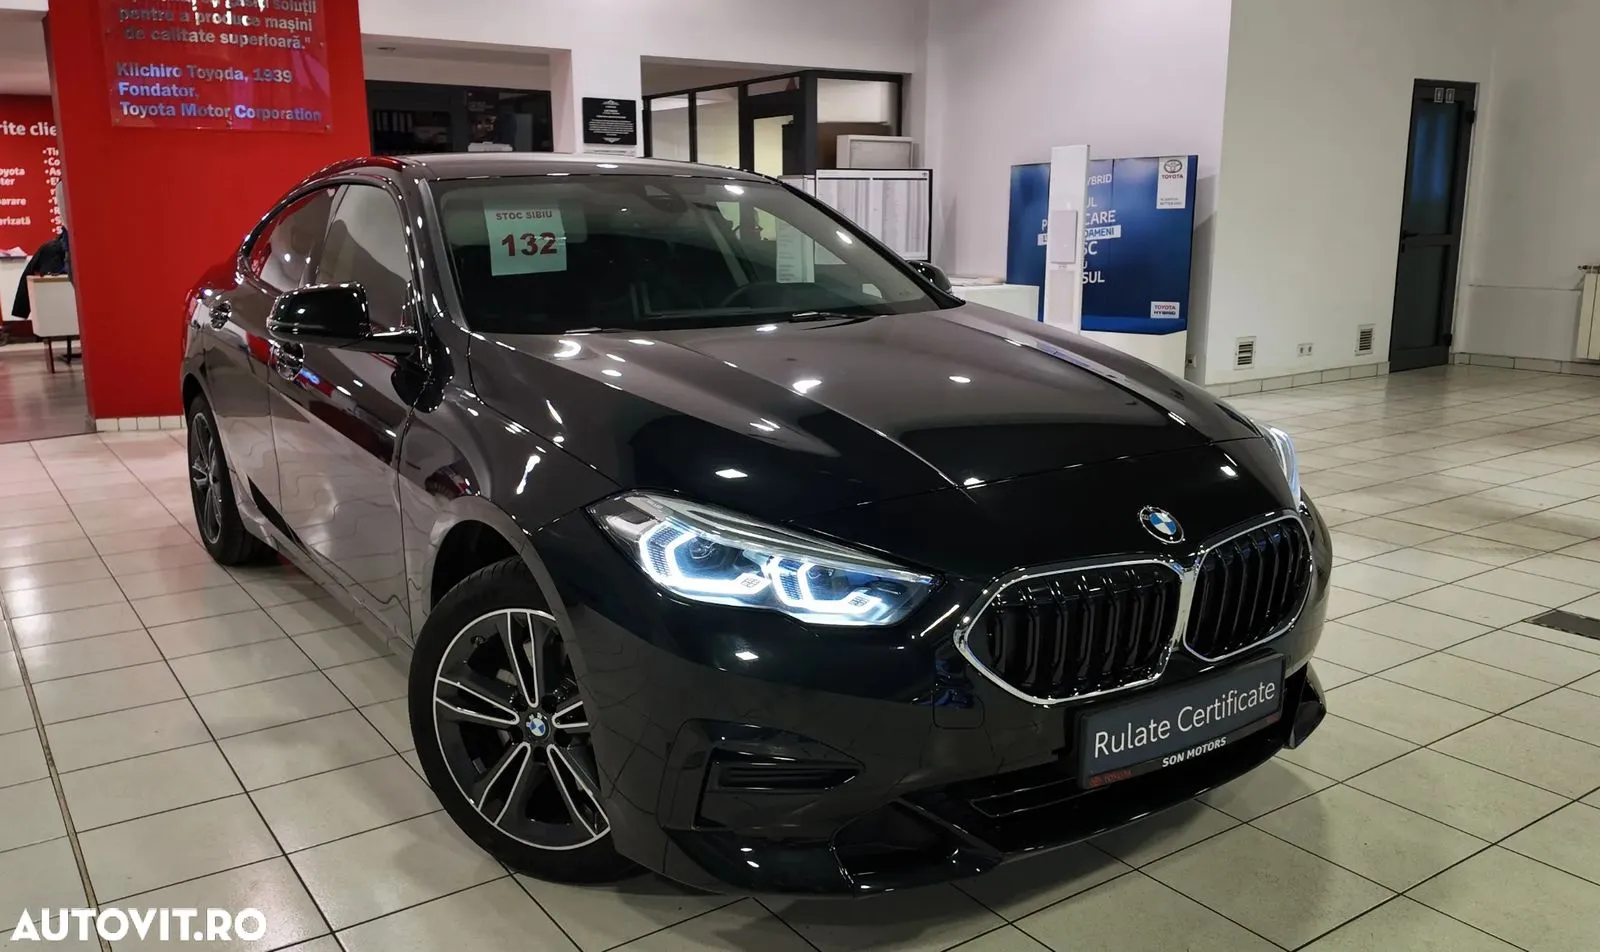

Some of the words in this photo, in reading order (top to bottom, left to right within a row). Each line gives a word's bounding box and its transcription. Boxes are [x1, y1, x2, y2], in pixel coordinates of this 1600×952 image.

[151, 28, 216, 43] calitate
[264, 17, 313, 33] mașini
[120, 101, 176, 119] Toyota
[181, 103, 231, 118] Motor
[234, 104, 322, 122] Corporation
[495, 212, 524, 221] STOC
[525, 210, 553, 220] SIBIU
[502, 232, 558, 257] 132
[1093, 719, 1171, 759] Rulate
[1177, 681, 1276, 732] Certificate
[1161, 753, 1185, 768] SON
[1186, 736, 1228, 760] MOTORS
